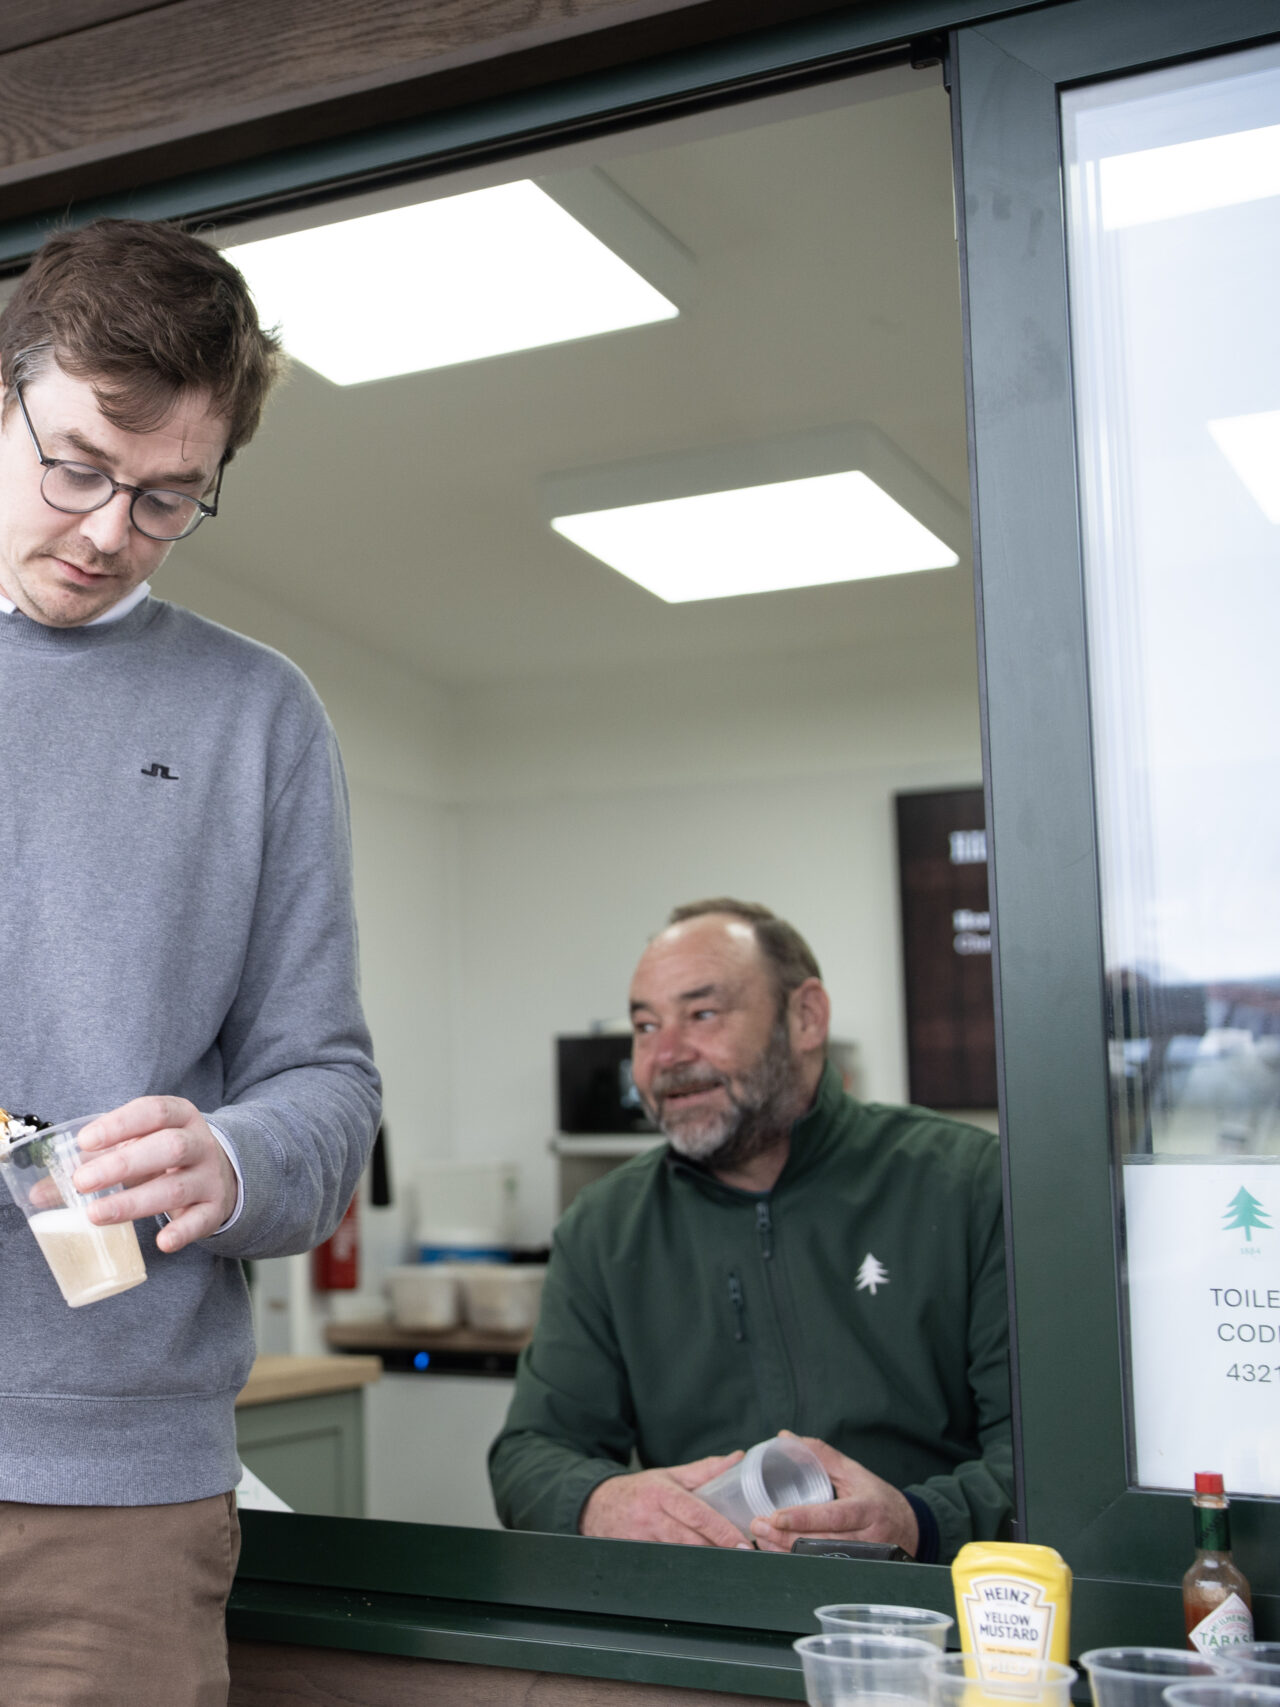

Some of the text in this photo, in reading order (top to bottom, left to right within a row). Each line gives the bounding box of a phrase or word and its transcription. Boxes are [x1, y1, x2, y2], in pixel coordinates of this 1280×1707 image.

[1217, 1323, 1280, 1343] COD
[984, 1587, 1030, 1605] HEINZ
[984, 1611, 1030, 1626] YELLOW
[980, 1624, 1038, 1641] MUSTARD
[1200, 1631, 1254, 1647] TABAS
